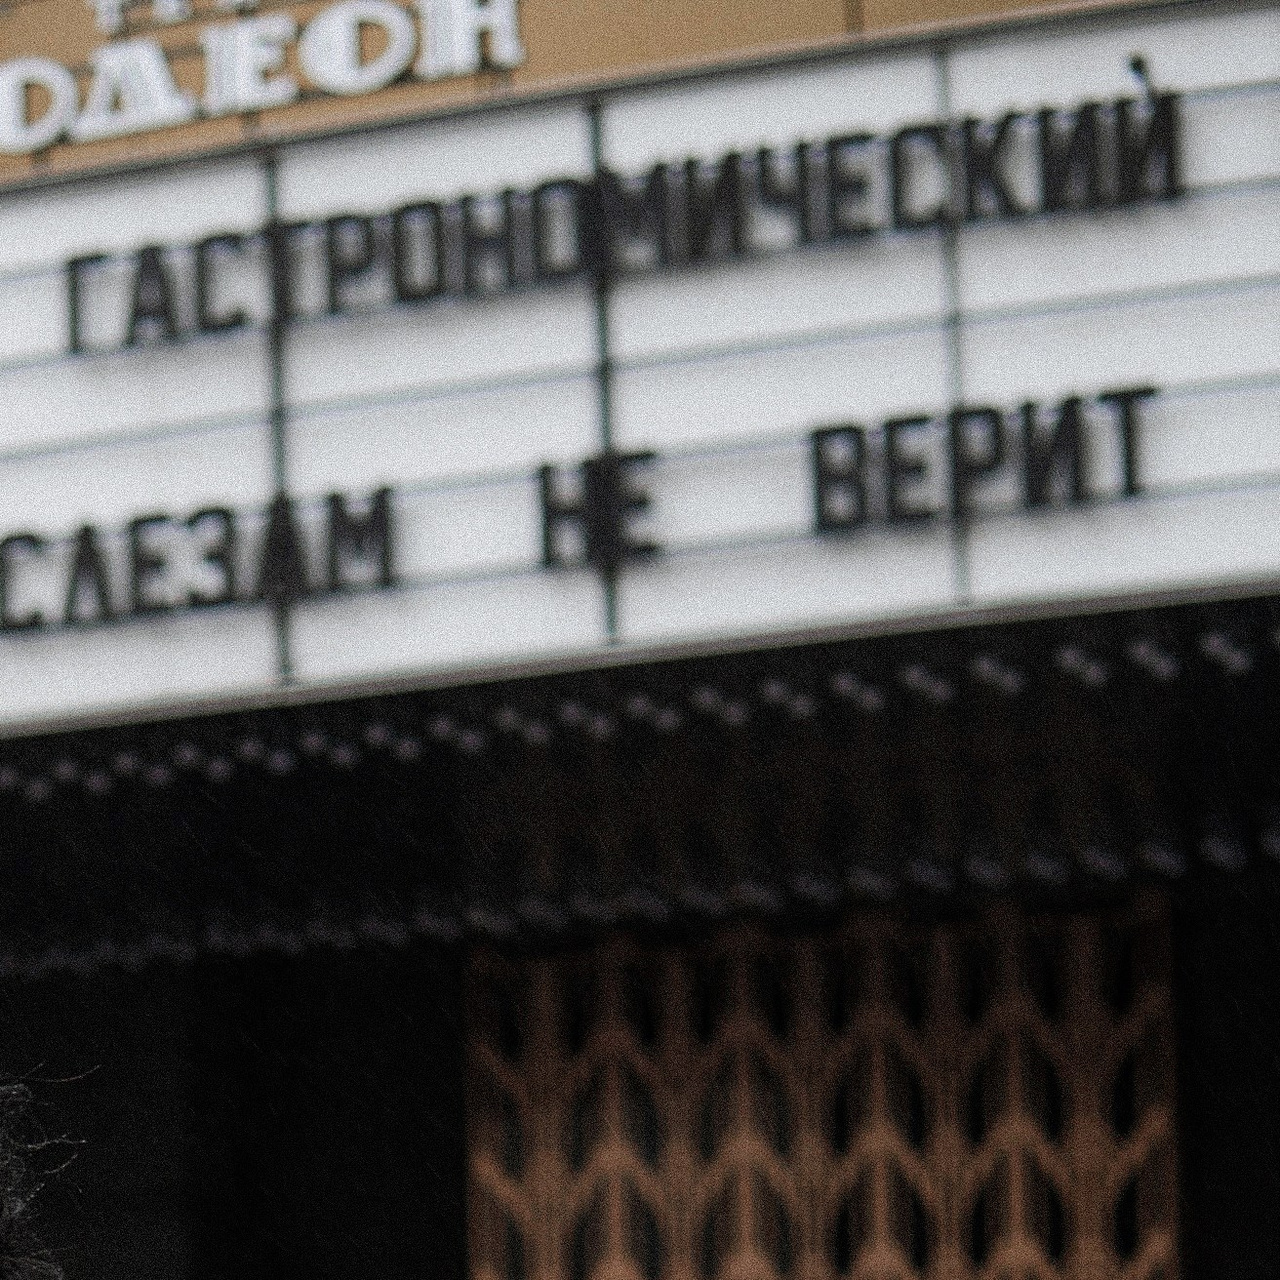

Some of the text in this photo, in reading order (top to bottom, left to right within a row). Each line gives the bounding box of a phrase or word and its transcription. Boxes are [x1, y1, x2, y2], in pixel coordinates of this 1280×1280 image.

[64, 50, 1188, 357] ГАСТРОНОМИЧЕСКИЙ
[534, 447, 659, 571] НЕ
[807, 384, 1158, 537] ВЕРИТ
